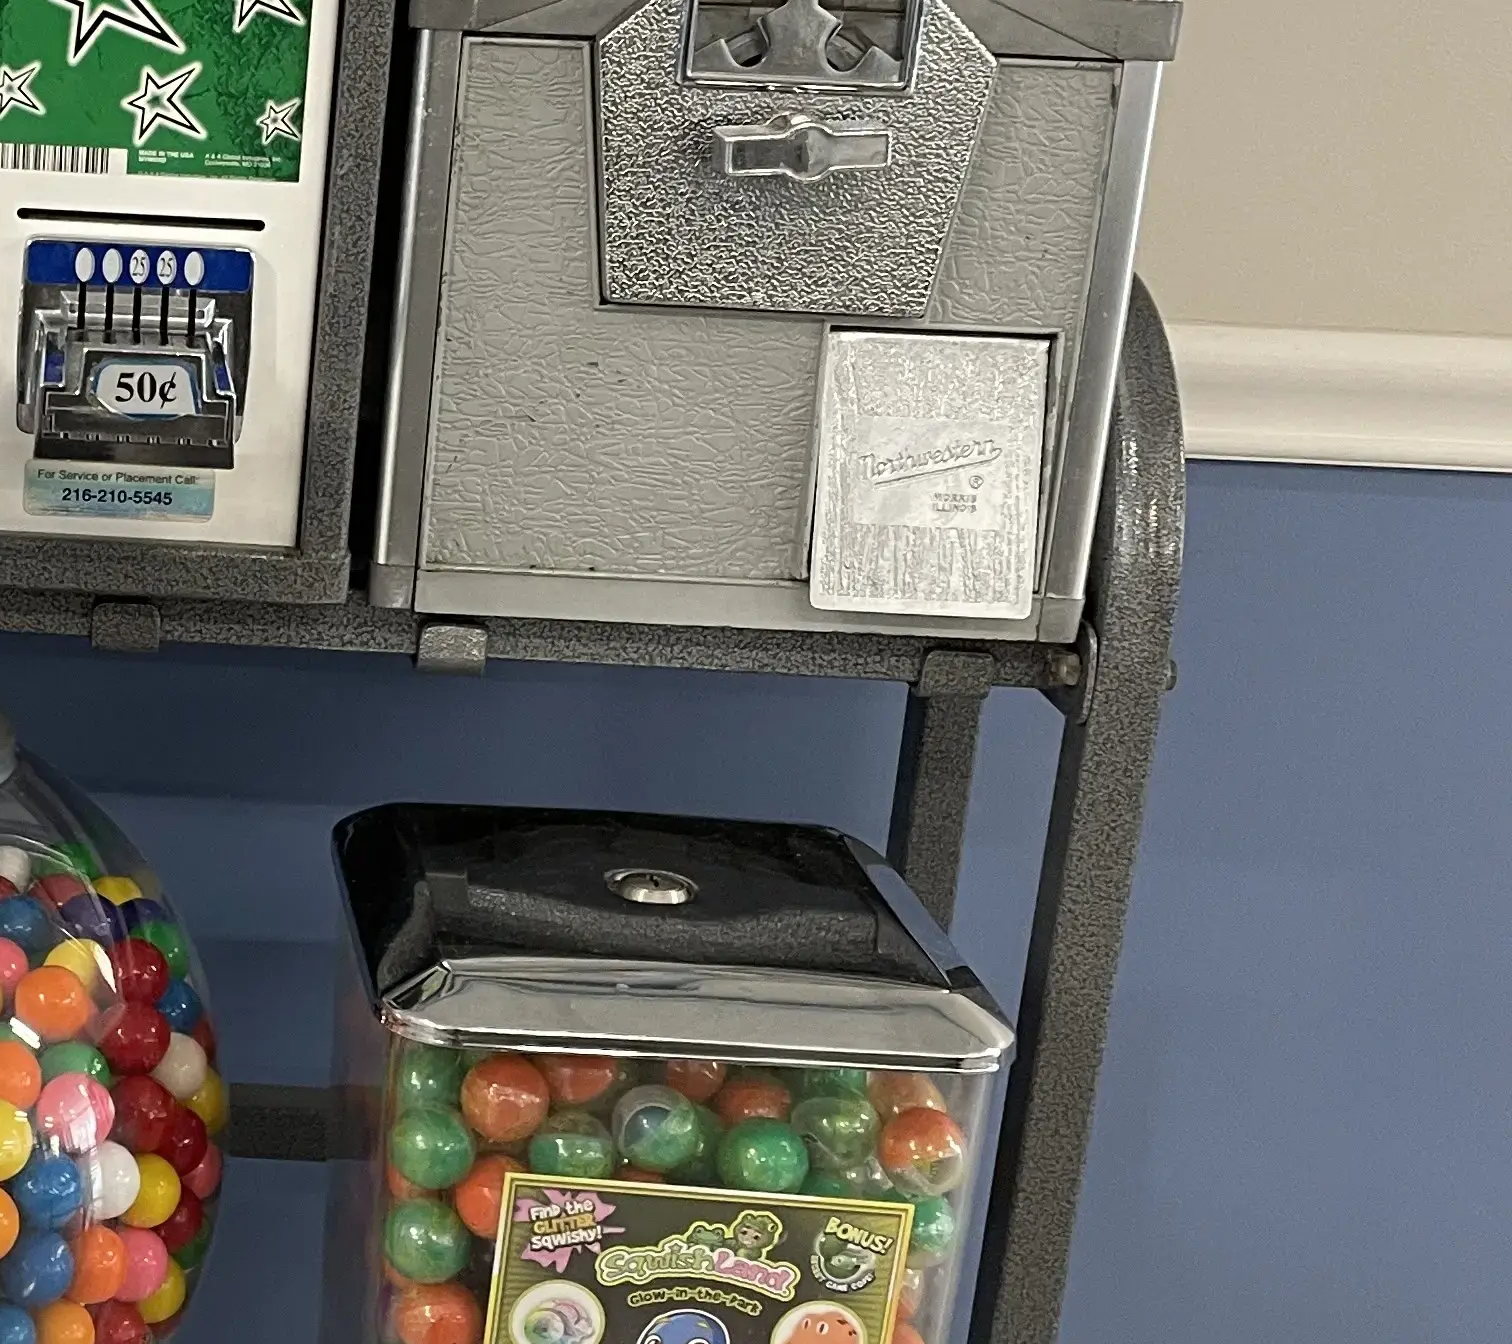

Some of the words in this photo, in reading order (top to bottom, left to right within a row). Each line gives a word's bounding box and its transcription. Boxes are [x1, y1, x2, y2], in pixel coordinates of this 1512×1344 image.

[114, 371, 179, 409] 50¢
[38, 469, 55, 480] For
[58, 470, 99, 482] Service
[101, 472, 113, 482] or
[115, 472, 173, 485] Placement
[61, 487, 173, 506] 216-210-5545
[564, 1199, 594, 1214] the
[533, 1214, 595, 1235] GLITTER
[824, 1216, 894, 1254] BONUS!
